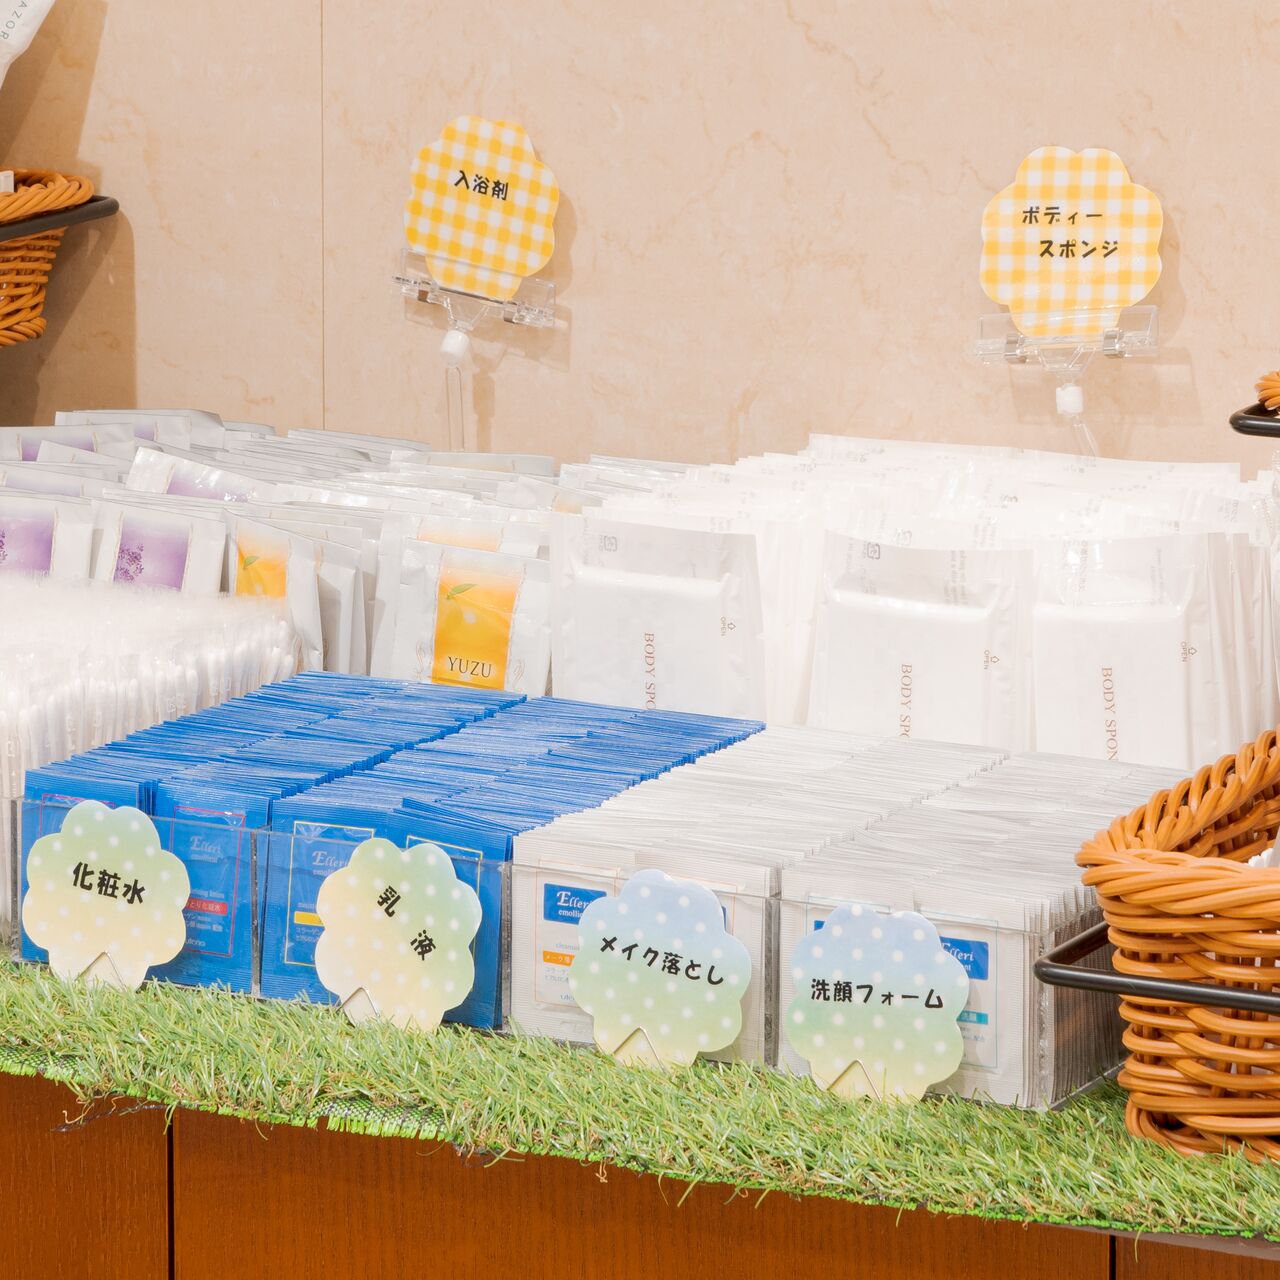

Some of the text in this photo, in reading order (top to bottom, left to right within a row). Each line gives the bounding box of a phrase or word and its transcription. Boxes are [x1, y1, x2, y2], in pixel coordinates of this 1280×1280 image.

[453, 169, 509, 201] 入浴剤
[1021, 205, 1104, 225] ボディー
[1039, 238, 1119, 259] スポンジ
[447, 655, 493, 679] YUZU
[644, 632, 657, 711] BODY SPO
[900, 663, 913, 710] BODY
[1101, 667, 1120, 762] BODY SPON
[72, 861, 146, 905] 化粧水
[600, 936, 725, 986] メイク落とし
[810, 978, 944, 1009] 洗顔フォーム
